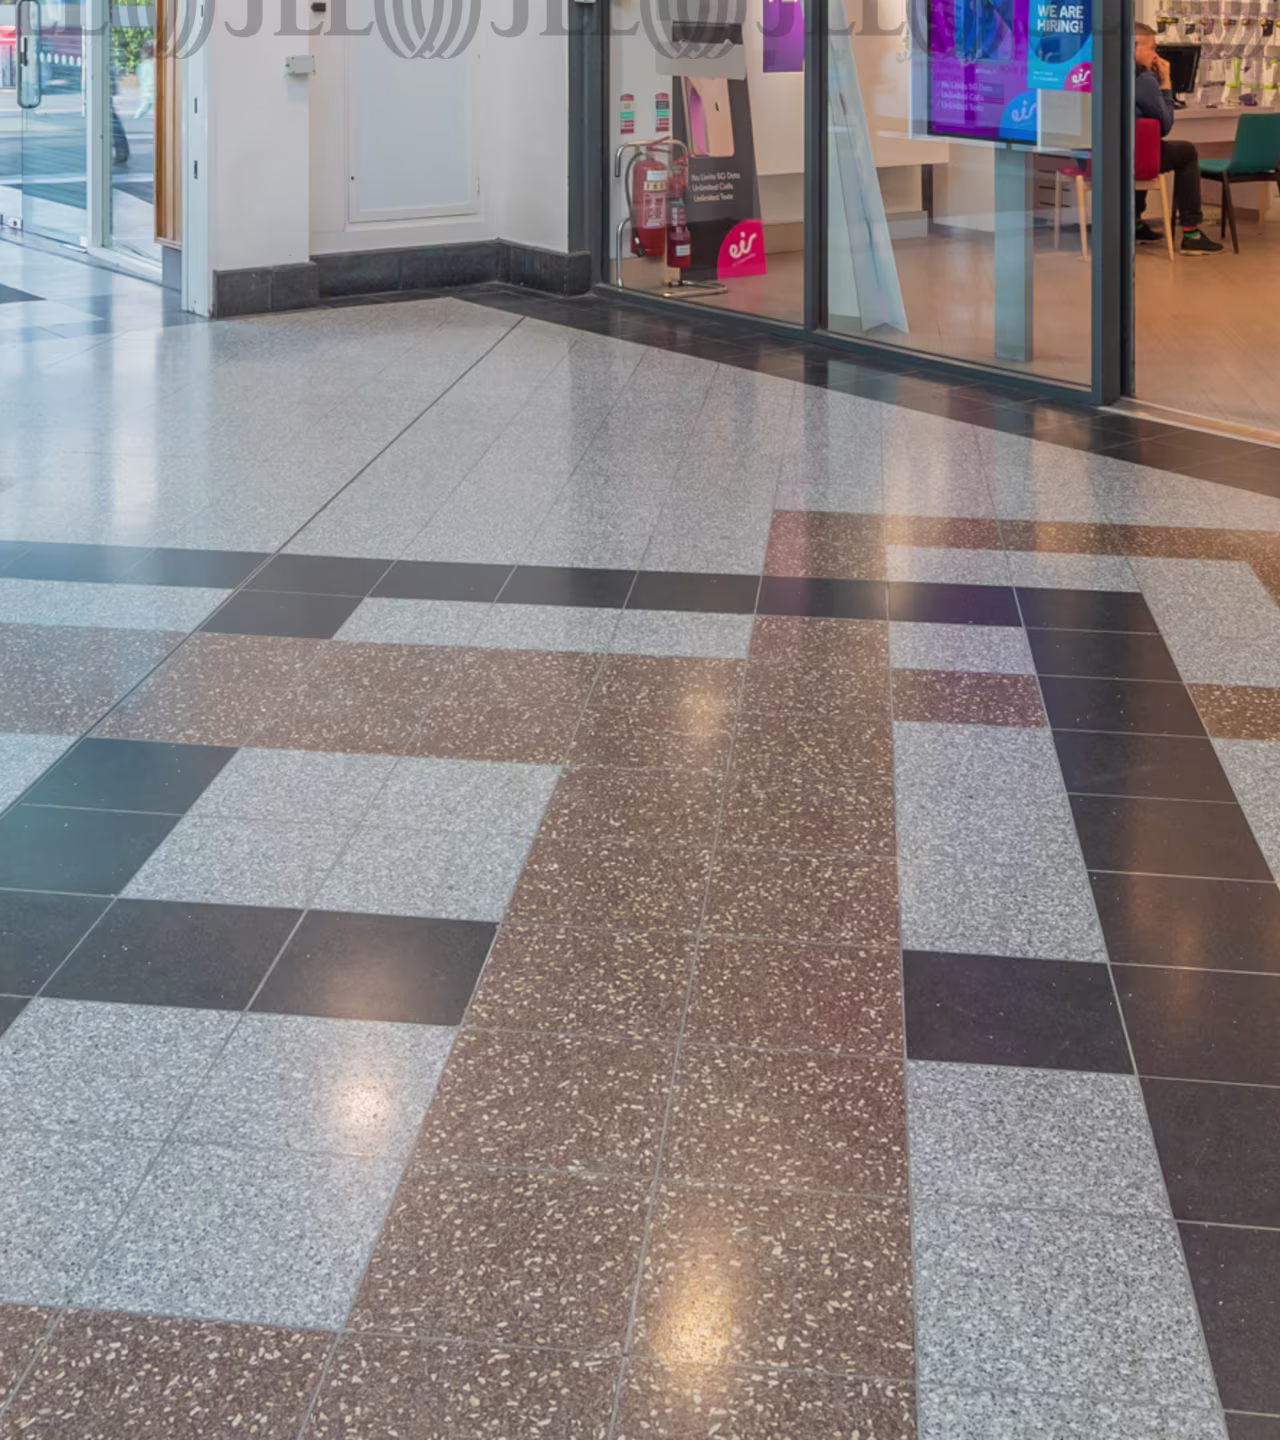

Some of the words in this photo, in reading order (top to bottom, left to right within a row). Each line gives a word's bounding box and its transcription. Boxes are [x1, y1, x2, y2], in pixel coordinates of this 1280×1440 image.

[1038, 5, 1057, 18] WE
[1059, 5, 1084, 19] ARE
[1037, 19, 1084, 34] HIRING!
[1072, 68, 1090, 84] eir
[729, 231, 757, 258] eir
